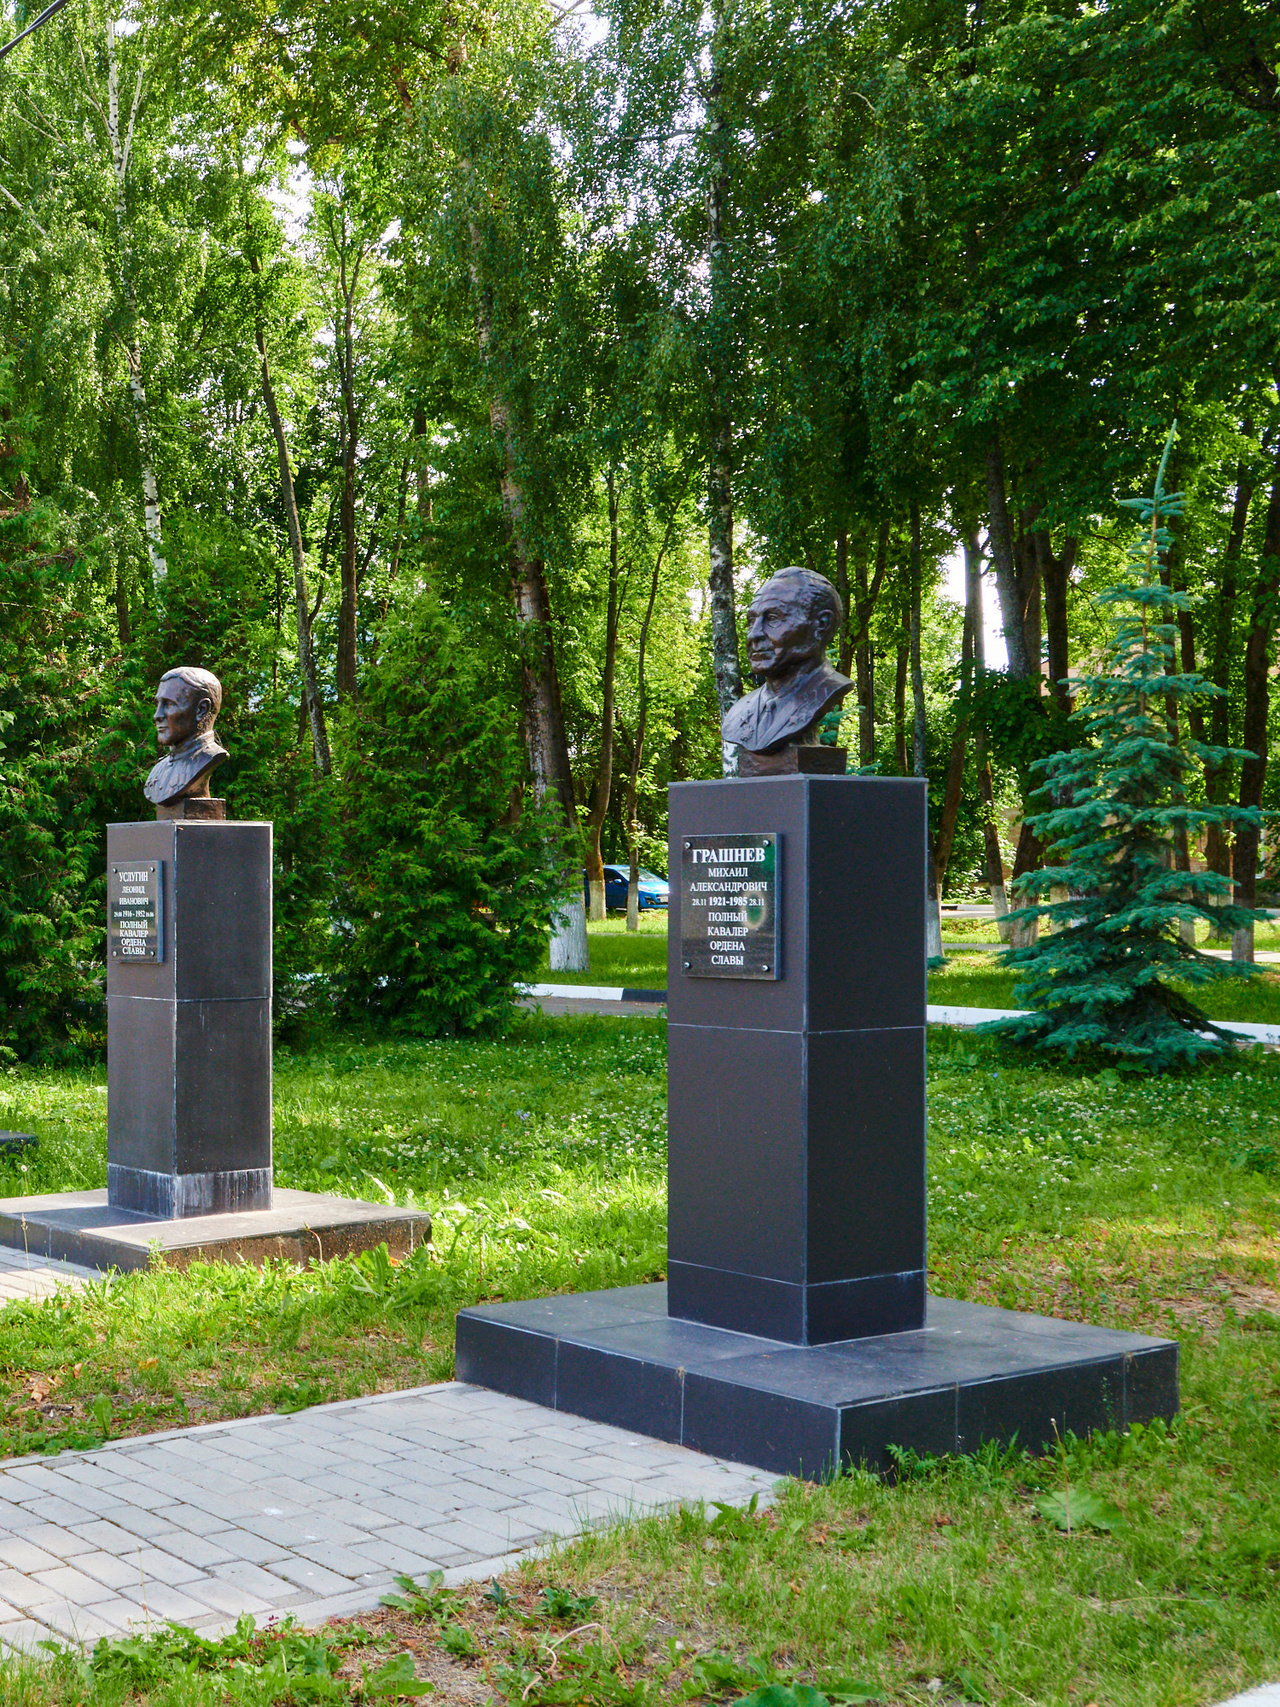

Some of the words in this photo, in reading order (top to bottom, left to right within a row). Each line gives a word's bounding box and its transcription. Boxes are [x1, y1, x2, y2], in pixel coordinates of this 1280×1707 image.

[692, 847, 766, 863] ГРАШНЕВ
[708, 867, 748, 877] МИХАИЛ
[689, 882, 768, 892] АЛЕКСАНДРОВИЧ
[708, 897, 748, 906] 1921-1985
[708, 911, 748, 922] ПОЛНЫЙ
[120, 920, 148, 929] ПОЛНЫЙ
[119, 929, 149, 937] КАВАЛЕР
[707, 927, 748, 936] КАВАЛЕР
[121, 938, 146, 947] ОРДЕНА
[710, 941, 745, 951] ОРДЕНА
[122, 947, 145, 955] СЛАВЫ
[711, 955, 744, 965] СЛАВЫ
